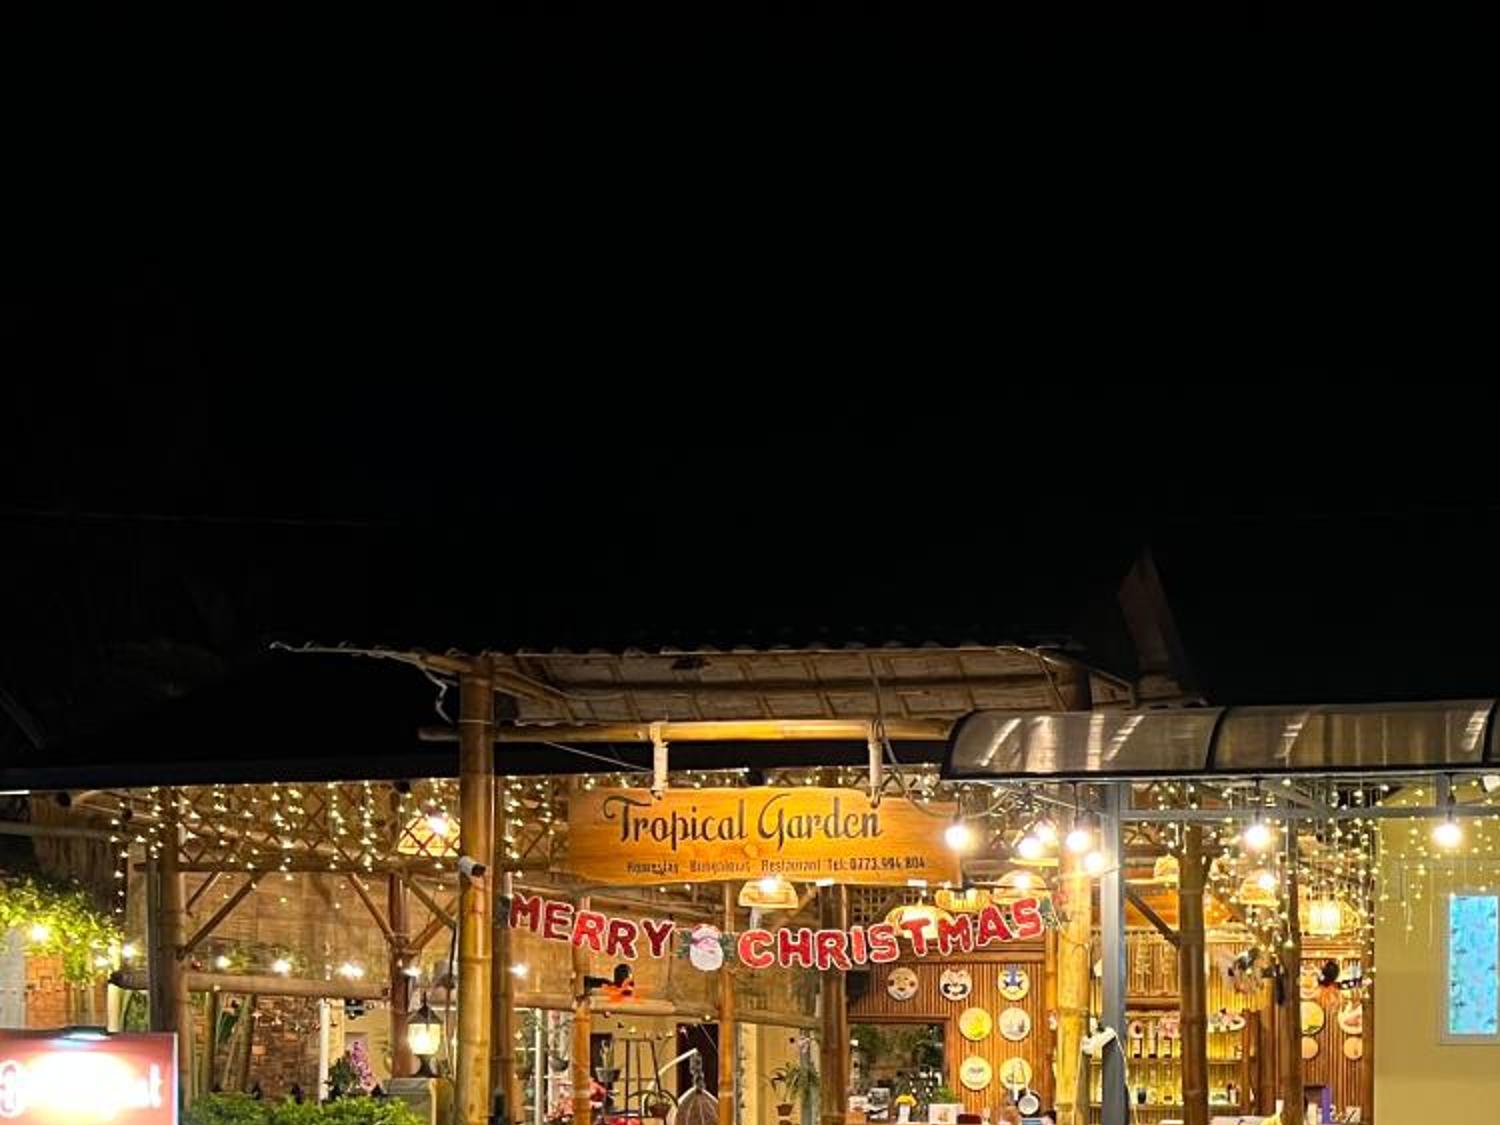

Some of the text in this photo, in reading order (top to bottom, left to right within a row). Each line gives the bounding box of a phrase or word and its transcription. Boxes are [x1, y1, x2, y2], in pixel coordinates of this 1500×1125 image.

[603, 793, 883, 851] Tropical Garden
[508, 893, 1044, 972] MERRY CHRISTMAS
